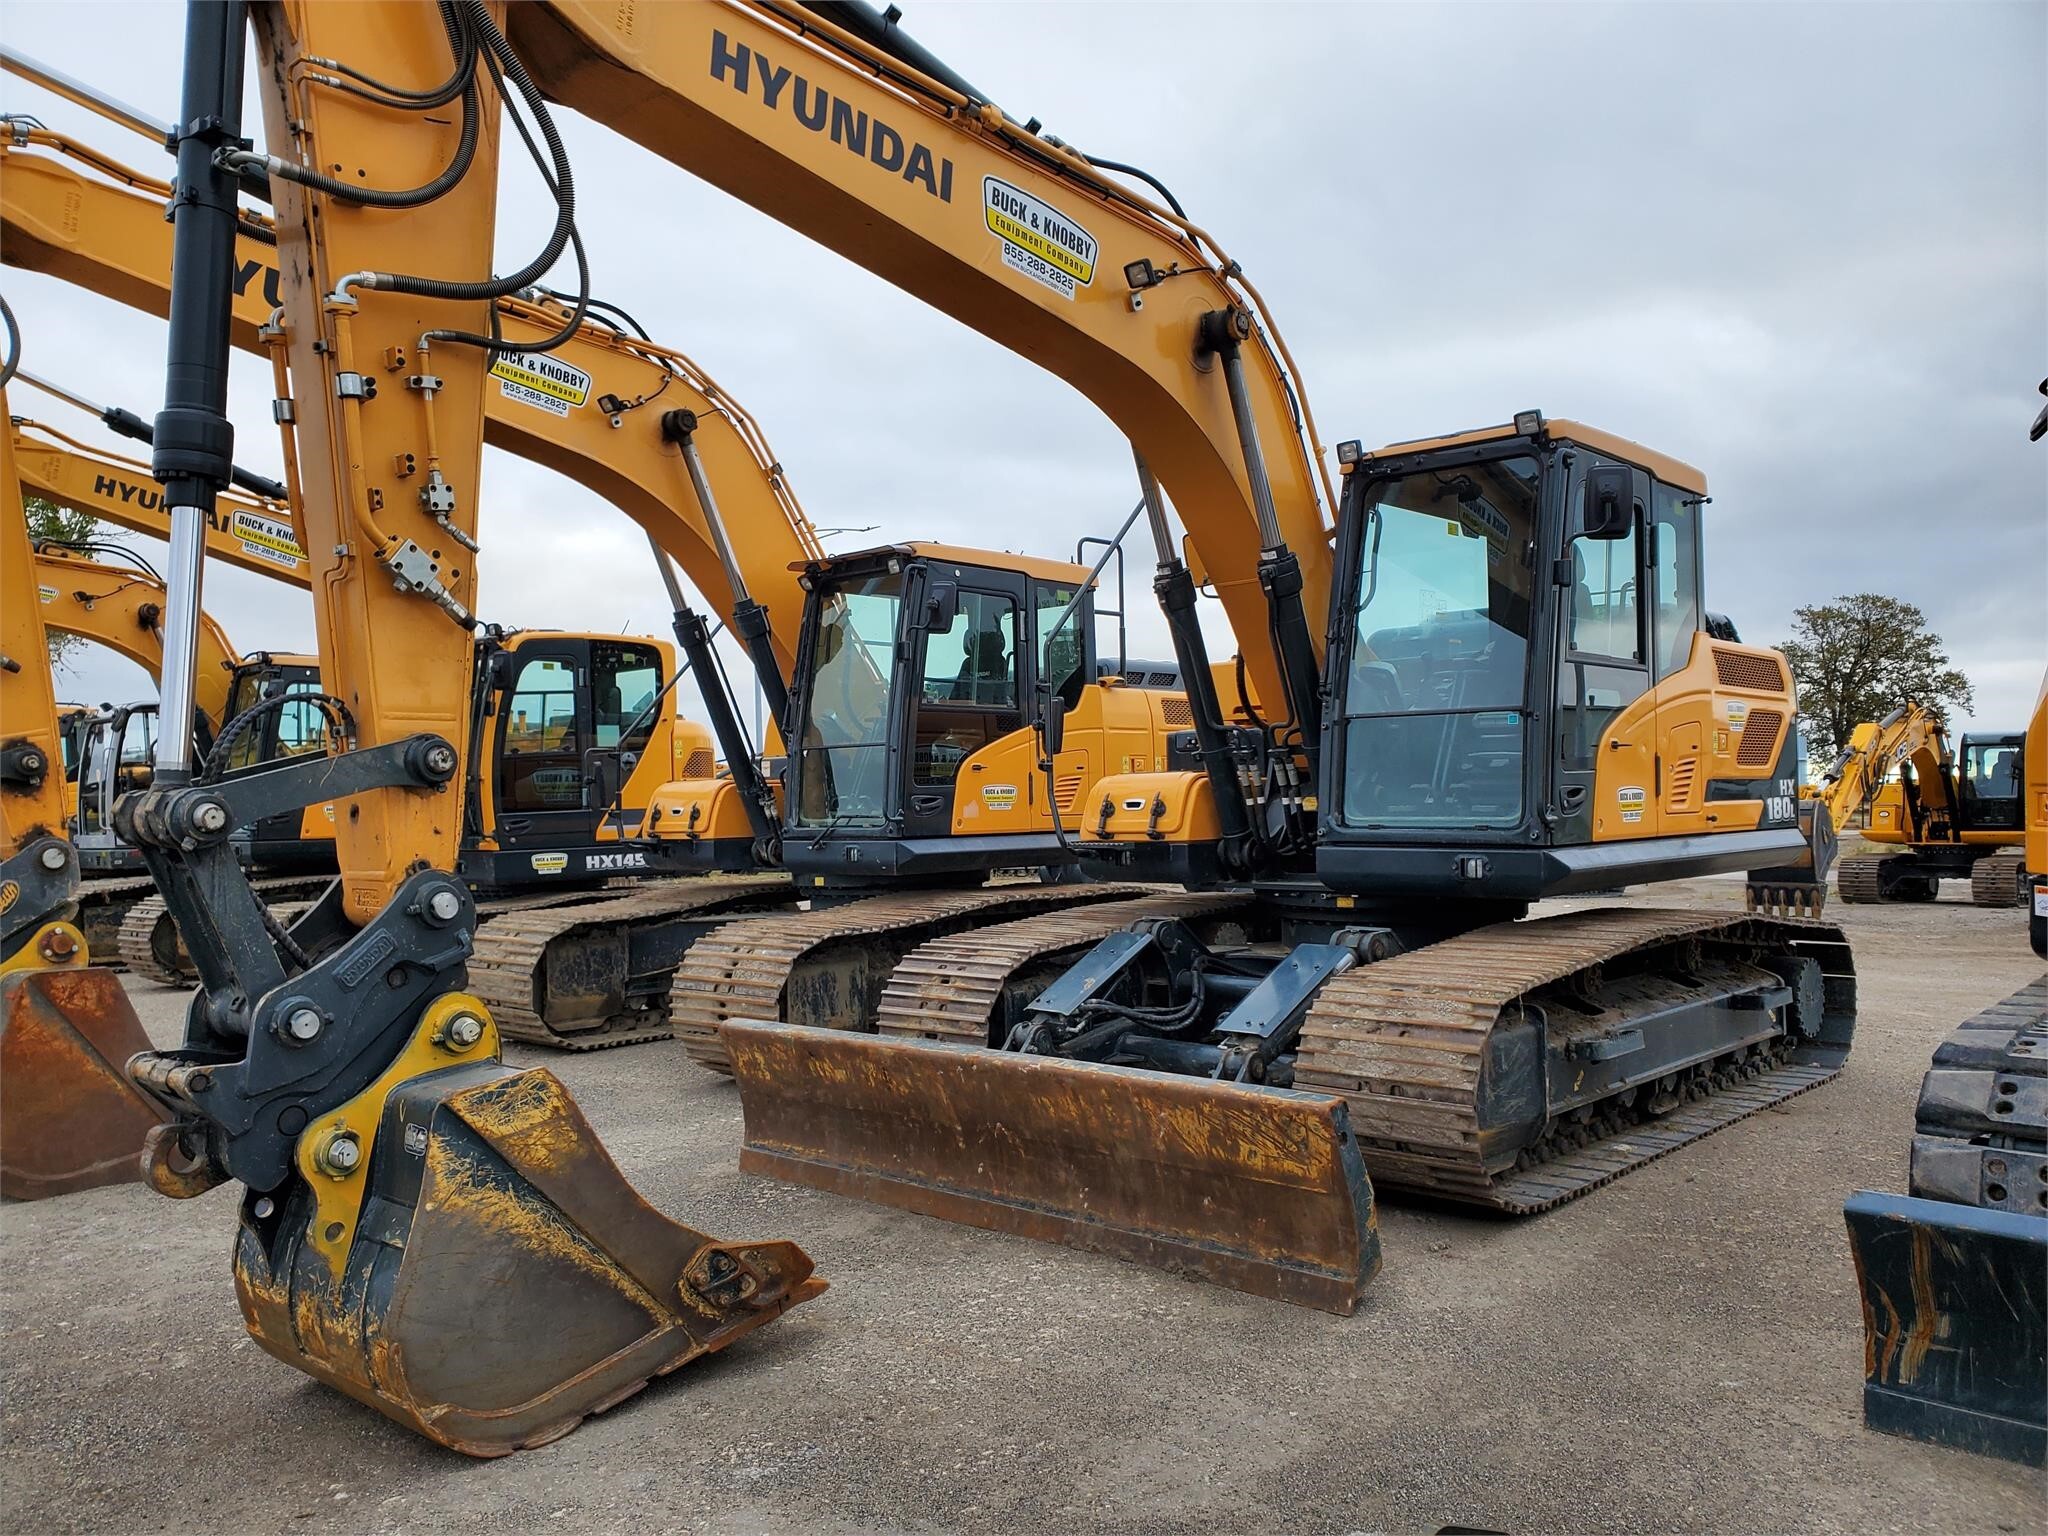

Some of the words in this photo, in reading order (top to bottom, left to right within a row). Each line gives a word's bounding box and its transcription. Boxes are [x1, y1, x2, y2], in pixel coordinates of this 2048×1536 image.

[710, 28, 953, 204] HYUNDAI
[991, 186, 1028, 223] BUCK
[1030, 212, 1040, 231] &
[1043, 216, 1092, 260] KNOBBY
[995, 214, 1043, 250] Equipment
[1046, 244, 1084, 274] Company
[1004, 242, 1074, 290] 855-288-2825
[496, 363, 539, 385] Equipment
[542, 380, 577, 399] Company
[498, 350, 525, 367] UCK
[528, 359, 536, 371] &
[540, 362, 585, 389] KNOBBY
[503, 381, 568, 411] 855-288-2825
[94, 474, 230, 533] HYUAI
[238, 515, 265, 532] BUCK
[266, 526, 273, 535] &
[276, 528, 297, 543] KNO
[1780, 779, 1795, 796] HX
[1767, 796, 1796, 820] 180L
[585, 853, 646, 869] HX145
[344, 938, 392, 982] HYUNDAI
